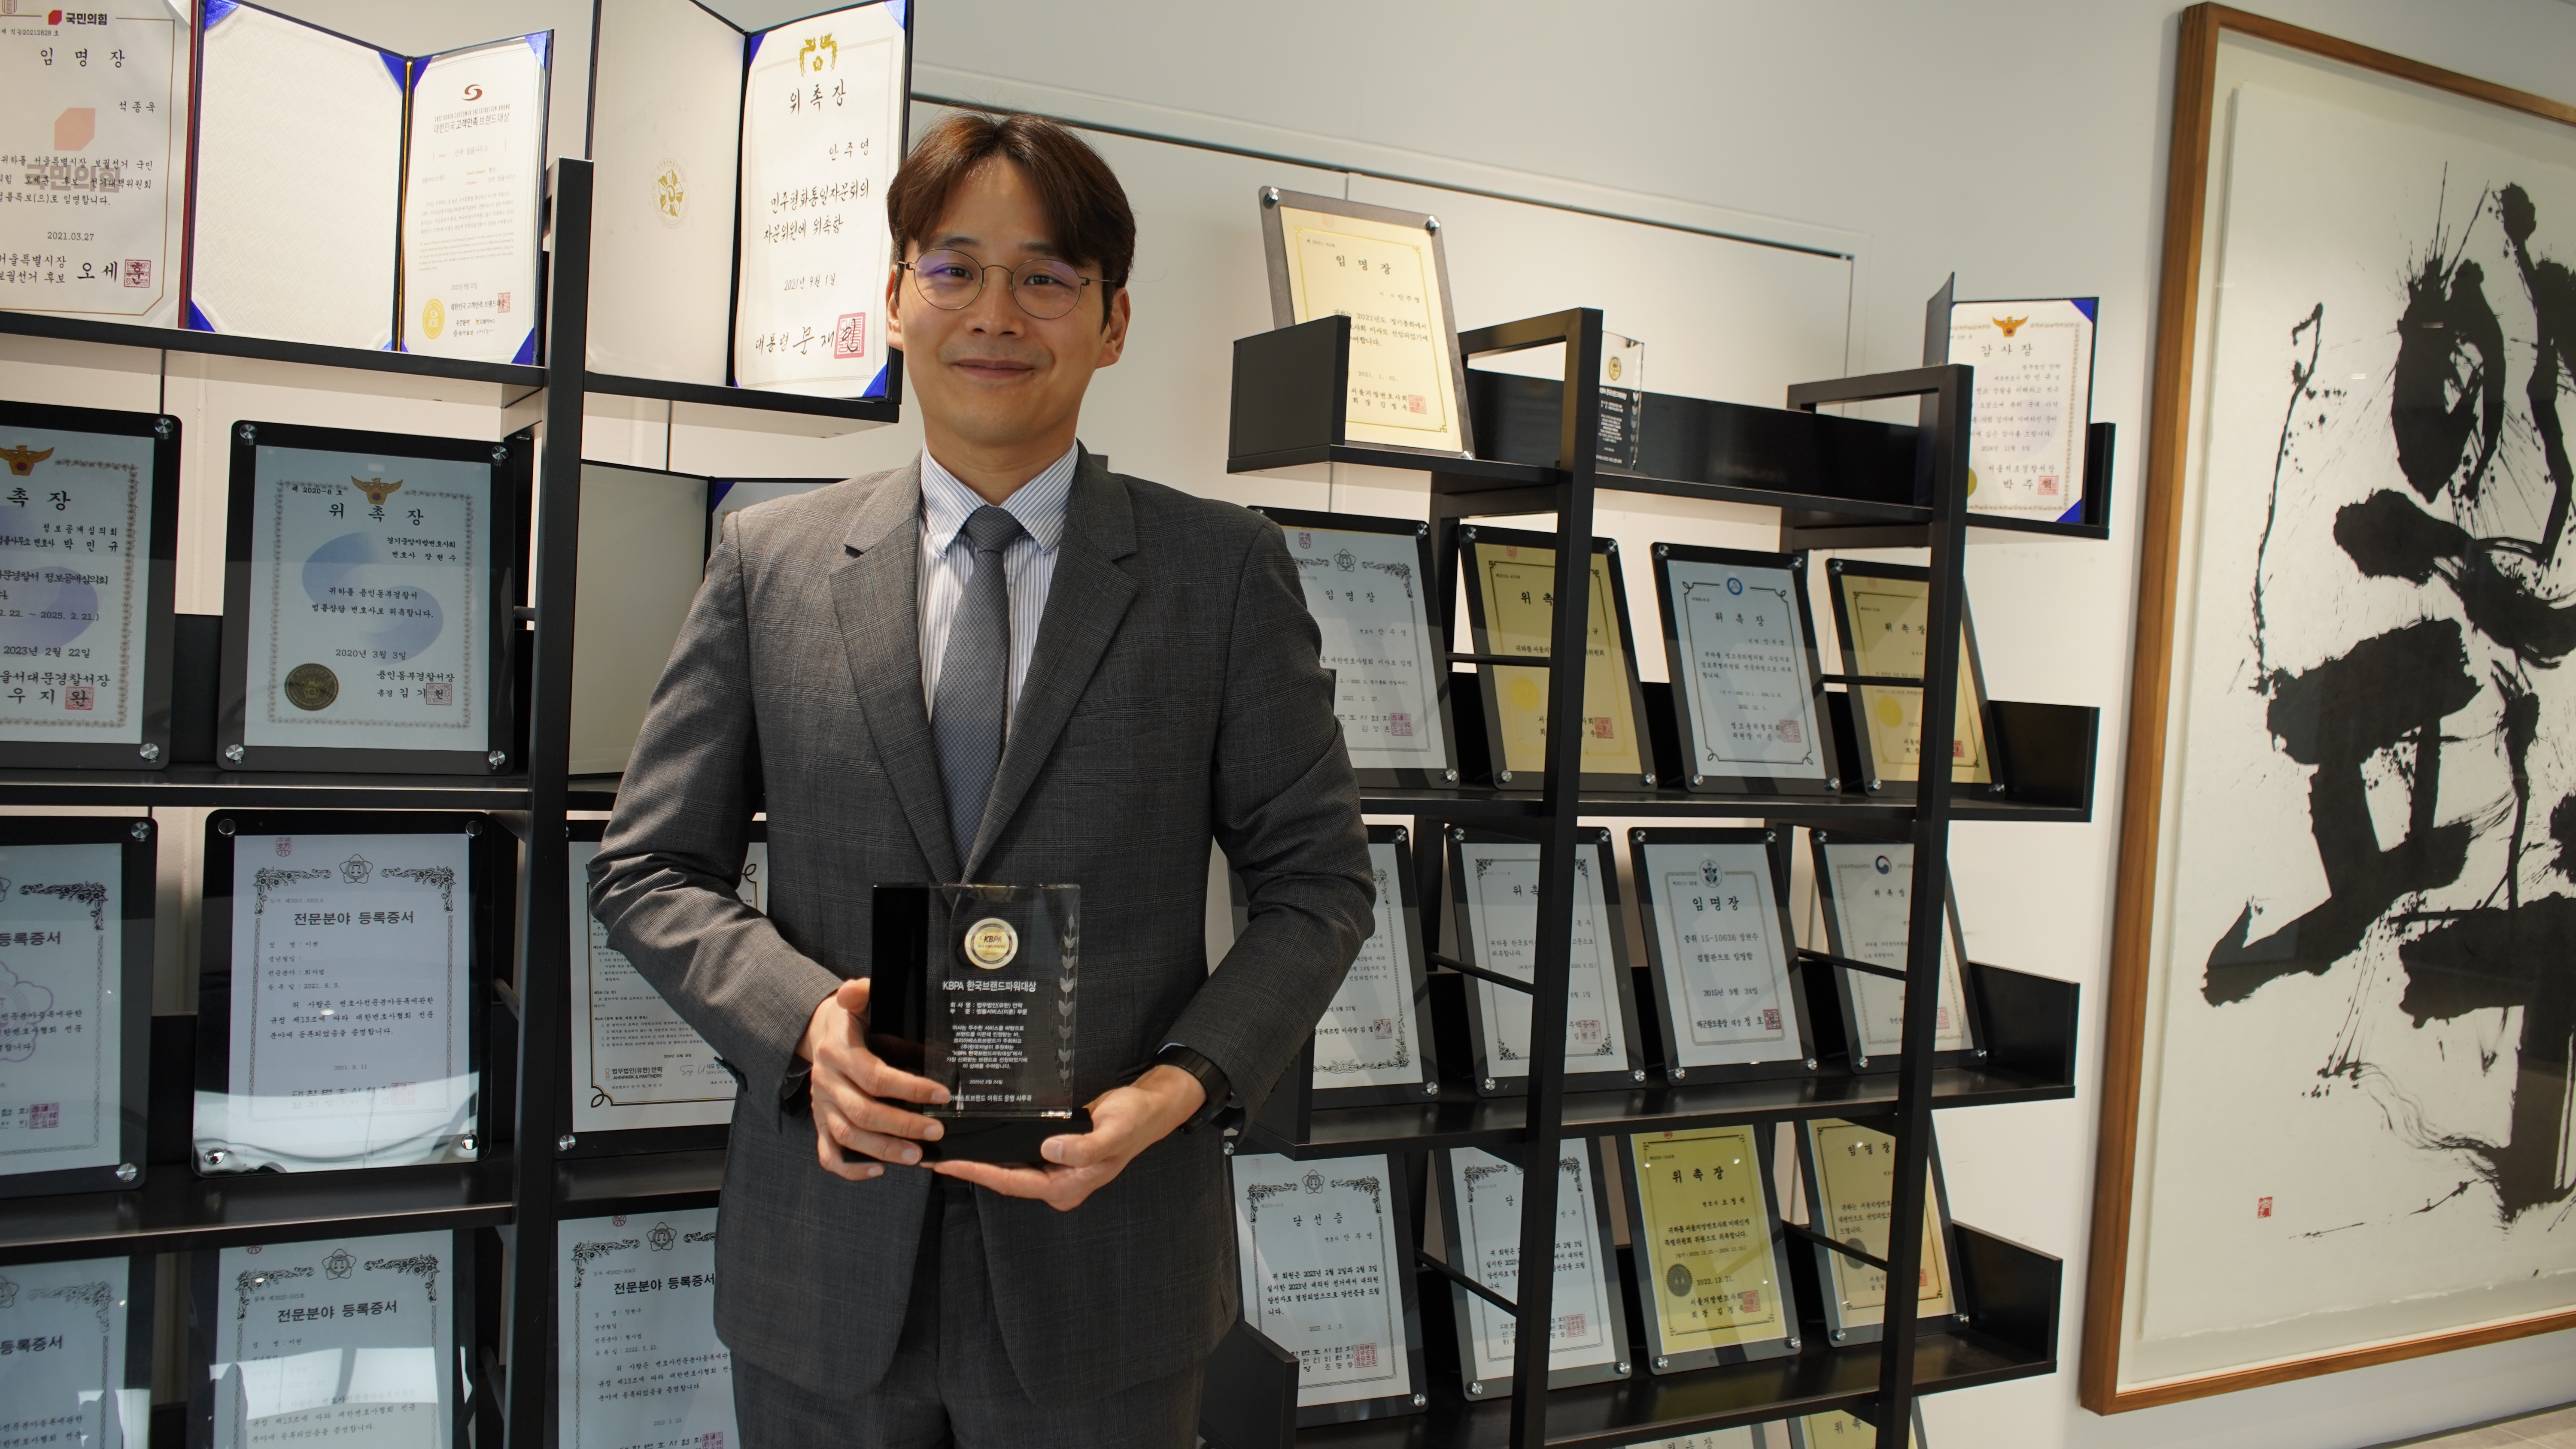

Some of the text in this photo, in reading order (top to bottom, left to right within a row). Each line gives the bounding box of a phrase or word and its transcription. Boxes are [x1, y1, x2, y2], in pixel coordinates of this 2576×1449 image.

[66, 13, 107, 25] 국민의힘
[455, 110, 471, 118] CUSTOMER
[473, 106, 497, 115] SATISFACTION
[434, 121, 455, 133] 대한민국
[456, 117, 478, 129] 고객만족
[1, 155, 152, 170] 귀하를 서울특별시장 보궐선거 국민
[24, 176, 152, 189] 오세훈 후보 선거대책위원회
[64, 194, 110, 205] 임명합니다.
[771, 178, 868, 214] 민주평화통일자문회의
[764, 214, 843, 243] 자문위원에 위촉함
[48, 232, 94, 241] 2021.03.27
[45, 272, 65, 284] 후보
[784, 273, 835, 291] 2021년 9월 1일
[1357, 313, 1386, 323] 2021년도
[756, 332, 788, 354] 대통령
[303, 486, 332, 496] 2020-8
[34, 538, 55, 547] 변호사
[387, 537, 455, 548] 경기중앙지방변호사회
[44, 572, 108, 585] 정보공개심의회
[328, 587, 417, 600] 귀하를 용인동부경찰서
[312, 603, 433, 618] 법률상담 변호사로 위촉합니다.
[3, 646, 90, 658] 2023년 2월 22일
[336, 649, 406, 660] 2020년 3월 3일
[377, 671, 455, 683] 용인동부경찰서장
[294, 911, 413, 925] 전문분야 등록증서
[943, 980, 1036, 992] KBPA 한국브랜드파워대상
[356, 1012, 410, 1021] 대한변호사협회
[352, 1028, 393, 1036] 증명합니다.
[614, 1273, 714, 1294] 전문분야 등록증서
[1267, 1284, 1285, 1292] 실시한
[1333, 1278, 1357, 1287] 선거에서
[1268, 1296, 1292, 1304] 당선자로
[1341, 1289, 1364, 1297] 당선증을
[278, 1300, 396, 1323] 전문분야 등록증서
